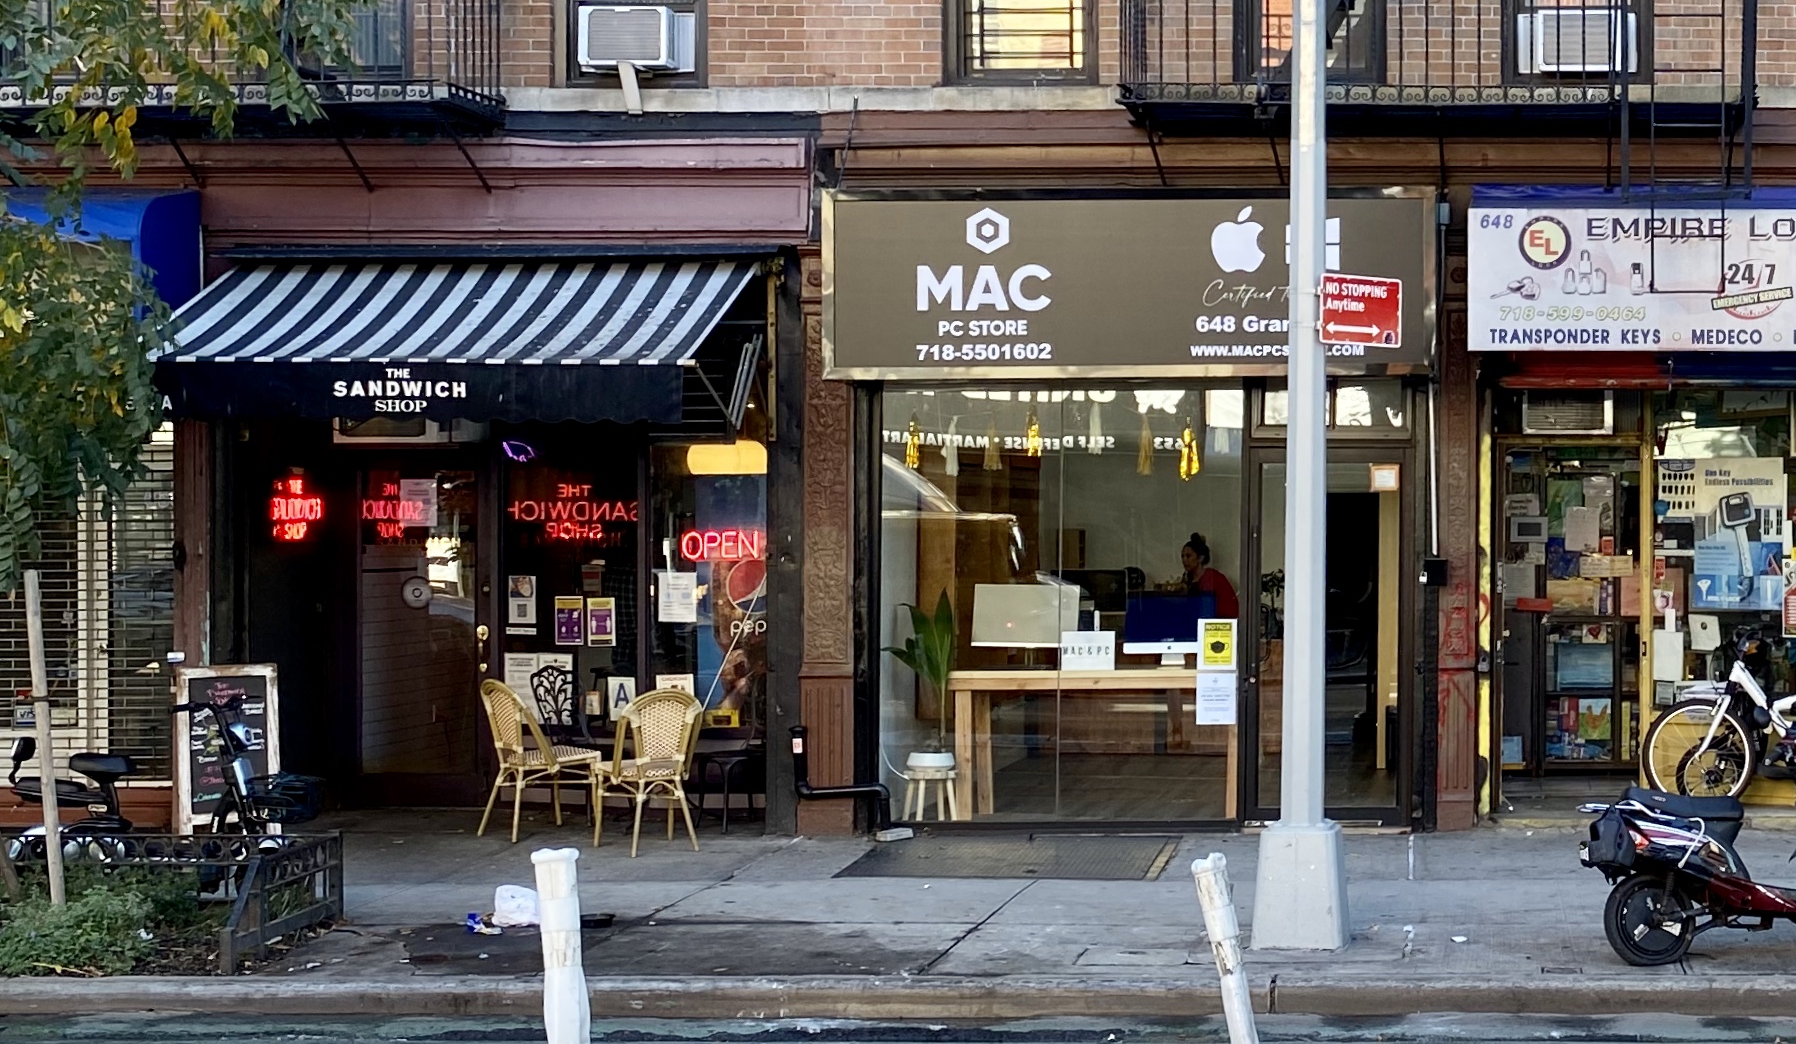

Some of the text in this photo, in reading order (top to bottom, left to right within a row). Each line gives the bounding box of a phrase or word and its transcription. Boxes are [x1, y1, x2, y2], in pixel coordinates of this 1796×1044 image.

[1480, 214, 1514, 229] 648
[1586, 217, 1731, 244] EMPIRE
[1529, 229, 1559, 256] EL
[916, 263, 1052, 311] MAC
[1202, 279, 1272, 308] Certified
[1326, 282, 1387, 299] NO STOPPING
[1326, 297, 1365, 313] Anytime
[1713, 288, 1792, 309] EMERGENCY SERVICE
[1500, 306, 1647, 321] 718-599-0464
[938, 319, 1028, 337] PC STORE
[1195, 315, 1236, 333] 648
[1490, 328, 1610, 345] TRANSPONDER
[1621, 328, 1661, 344] KEYS
[1691, 329, 1763, 345] MEDECO
[916, 343, 1052, 361] 718-5501602
[386, 368, 411, 379] THE
[333, 380, 467, 398] SANDWICH
[375, 399, 427, 413] SHOP
[682, 530, 759, 560] OPEN
[730, 619, 767, 637] pep
[1062, 646, 1110, 655] MAC & PC
[614, 683, 630, 708] A
